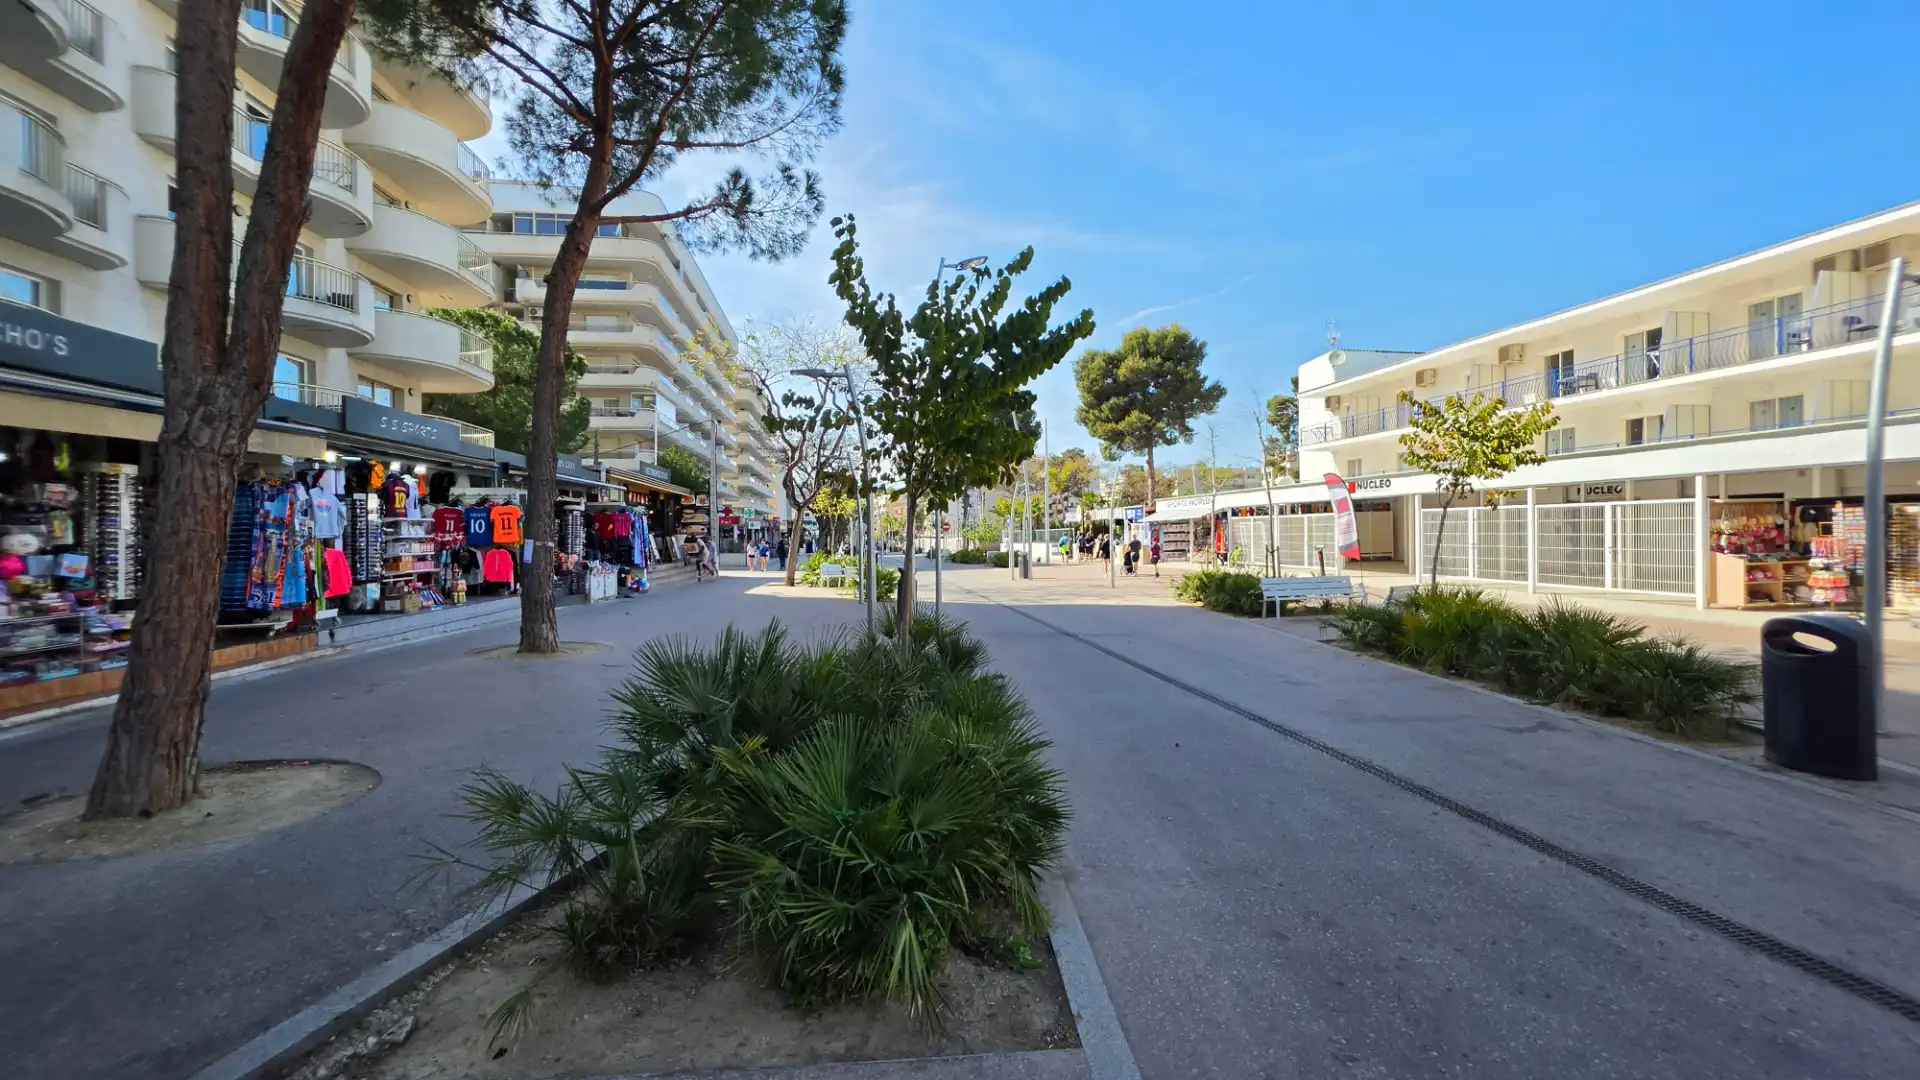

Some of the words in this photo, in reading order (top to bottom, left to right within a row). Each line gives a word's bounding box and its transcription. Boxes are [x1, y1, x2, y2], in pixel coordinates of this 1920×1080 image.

[1356, 478, 1392, 490] NUCLEO
[445, 519, 455, 532] 11
[470, 518, 486, 534] 10
[500, 517, 512, 531] 11
